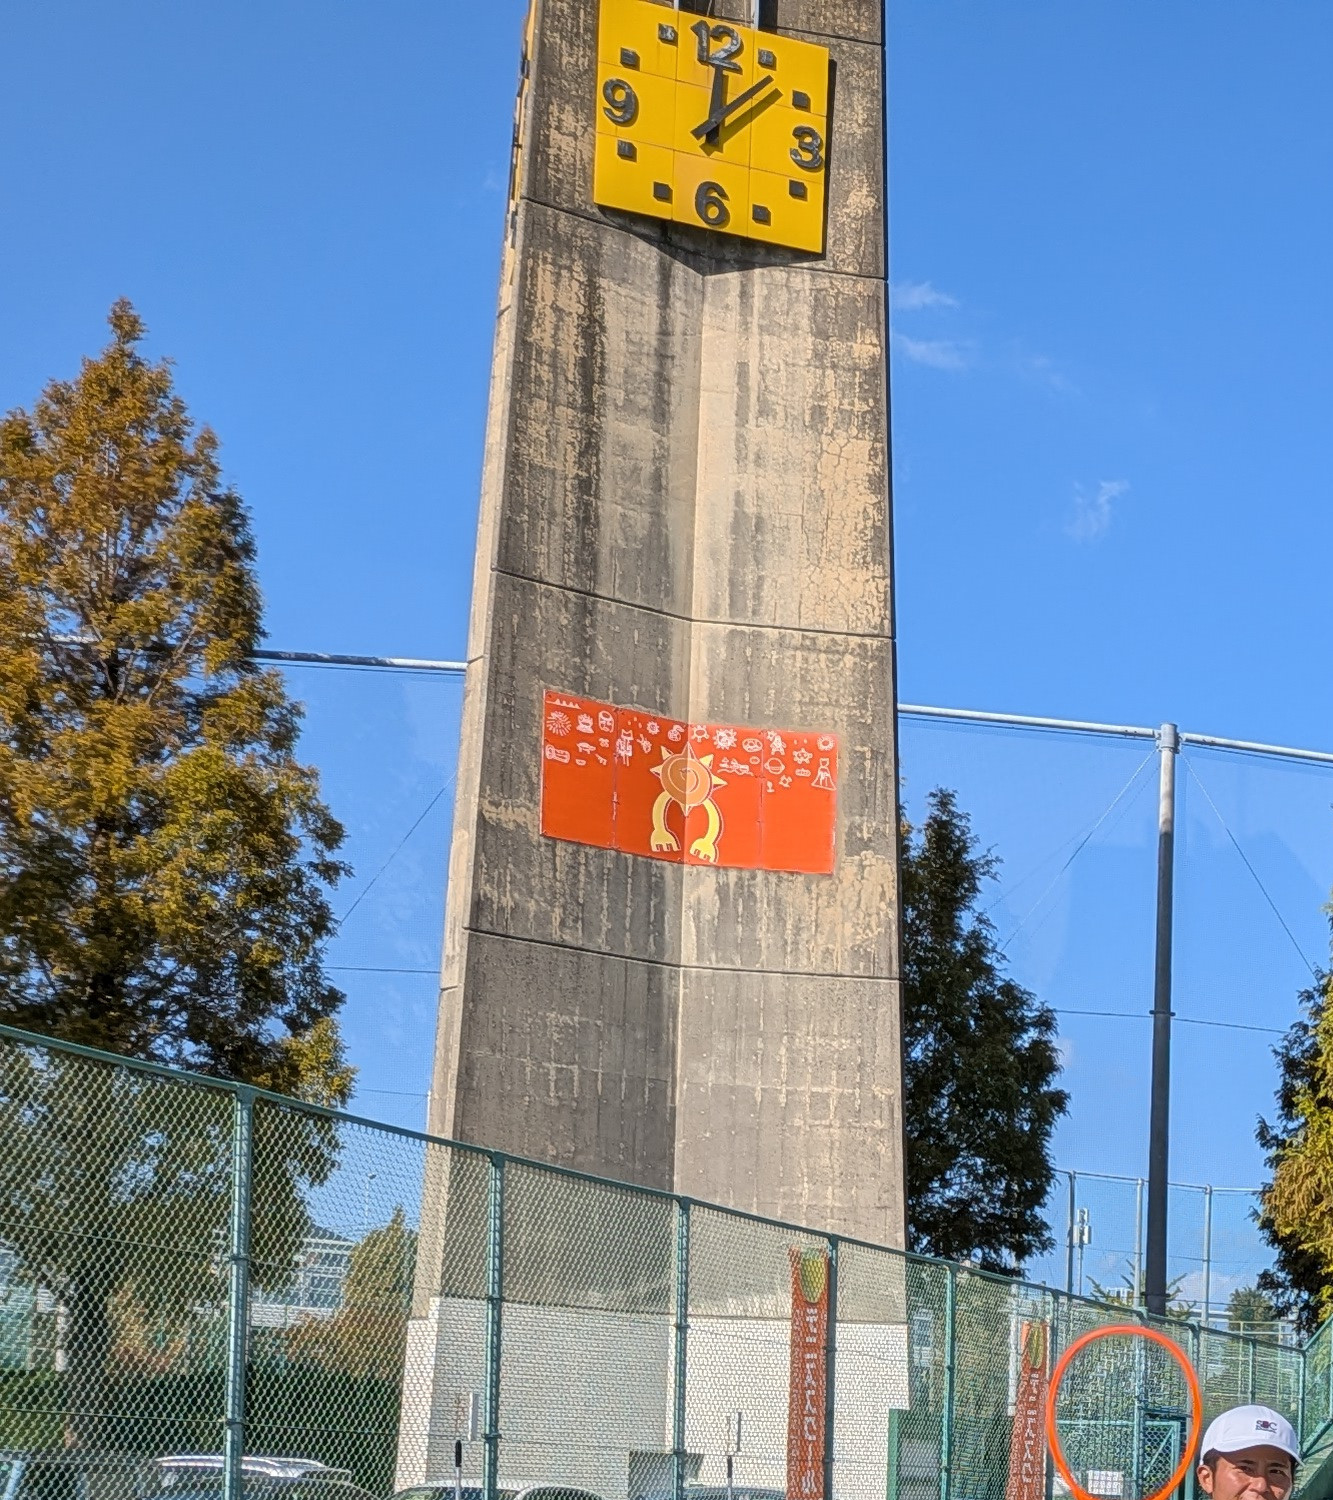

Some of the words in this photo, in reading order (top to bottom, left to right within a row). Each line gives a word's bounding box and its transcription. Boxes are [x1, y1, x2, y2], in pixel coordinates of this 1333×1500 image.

[691, 20, 742, 72] 12
[603, 78, 637, 124] 9
[790, 125, 823, 169] 3
[695, 181, 728, 226] 6
